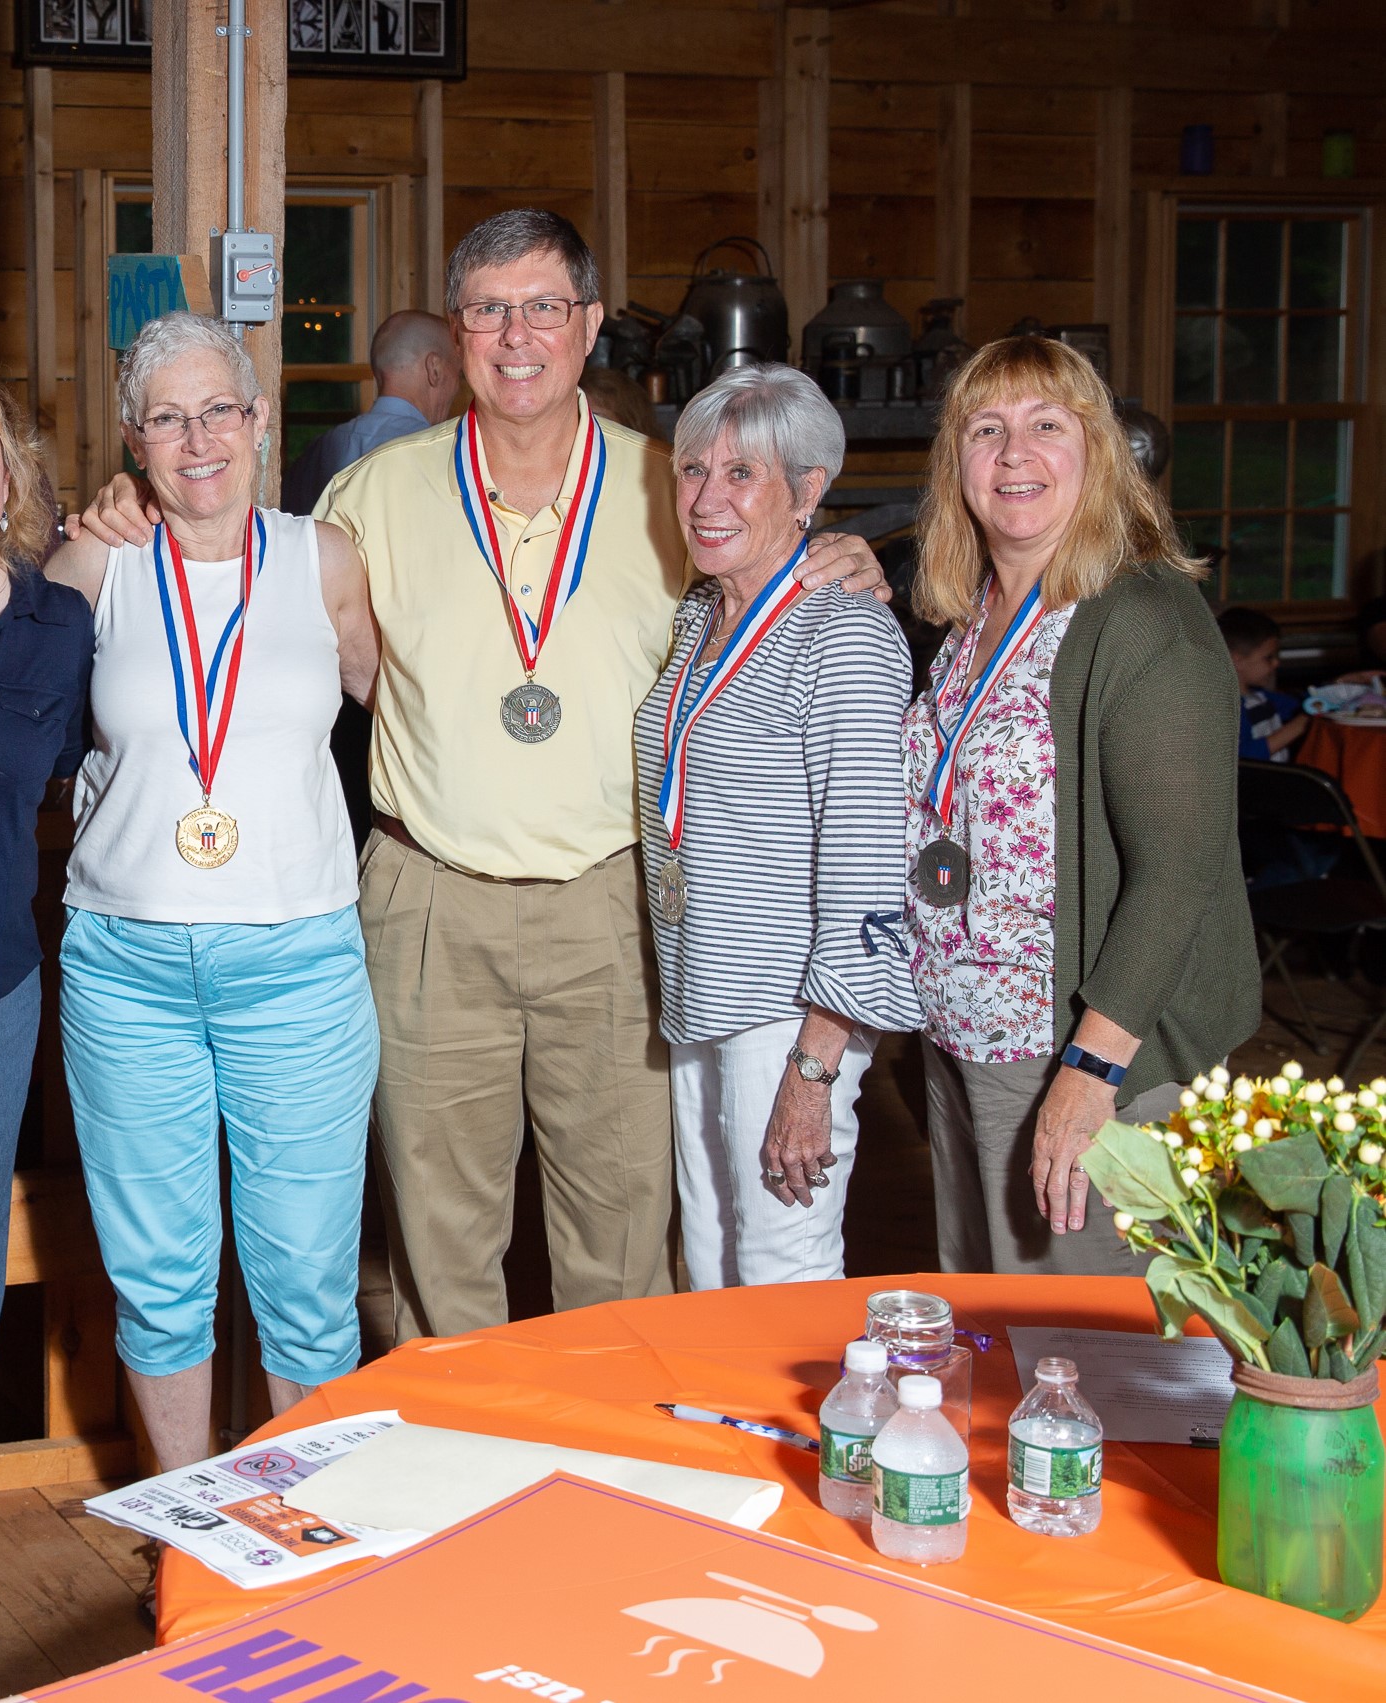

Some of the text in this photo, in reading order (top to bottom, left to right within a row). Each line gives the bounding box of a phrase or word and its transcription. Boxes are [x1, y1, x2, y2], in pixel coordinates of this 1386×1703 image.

[110, 261, 181, 346] PARTY
[848, 1455, 873, 1472] Spr
[117, 1497, 154, 1513] 4,821
[196, 1489, 224, 1503] 90%
[228, 1508, 301, 1547] THE PANTRY SERVES
[220, 1533, 254, 1551] FOOD
[158, 1627, 476, 1703] NTH
[473, 1664, 585, 1703] us!
